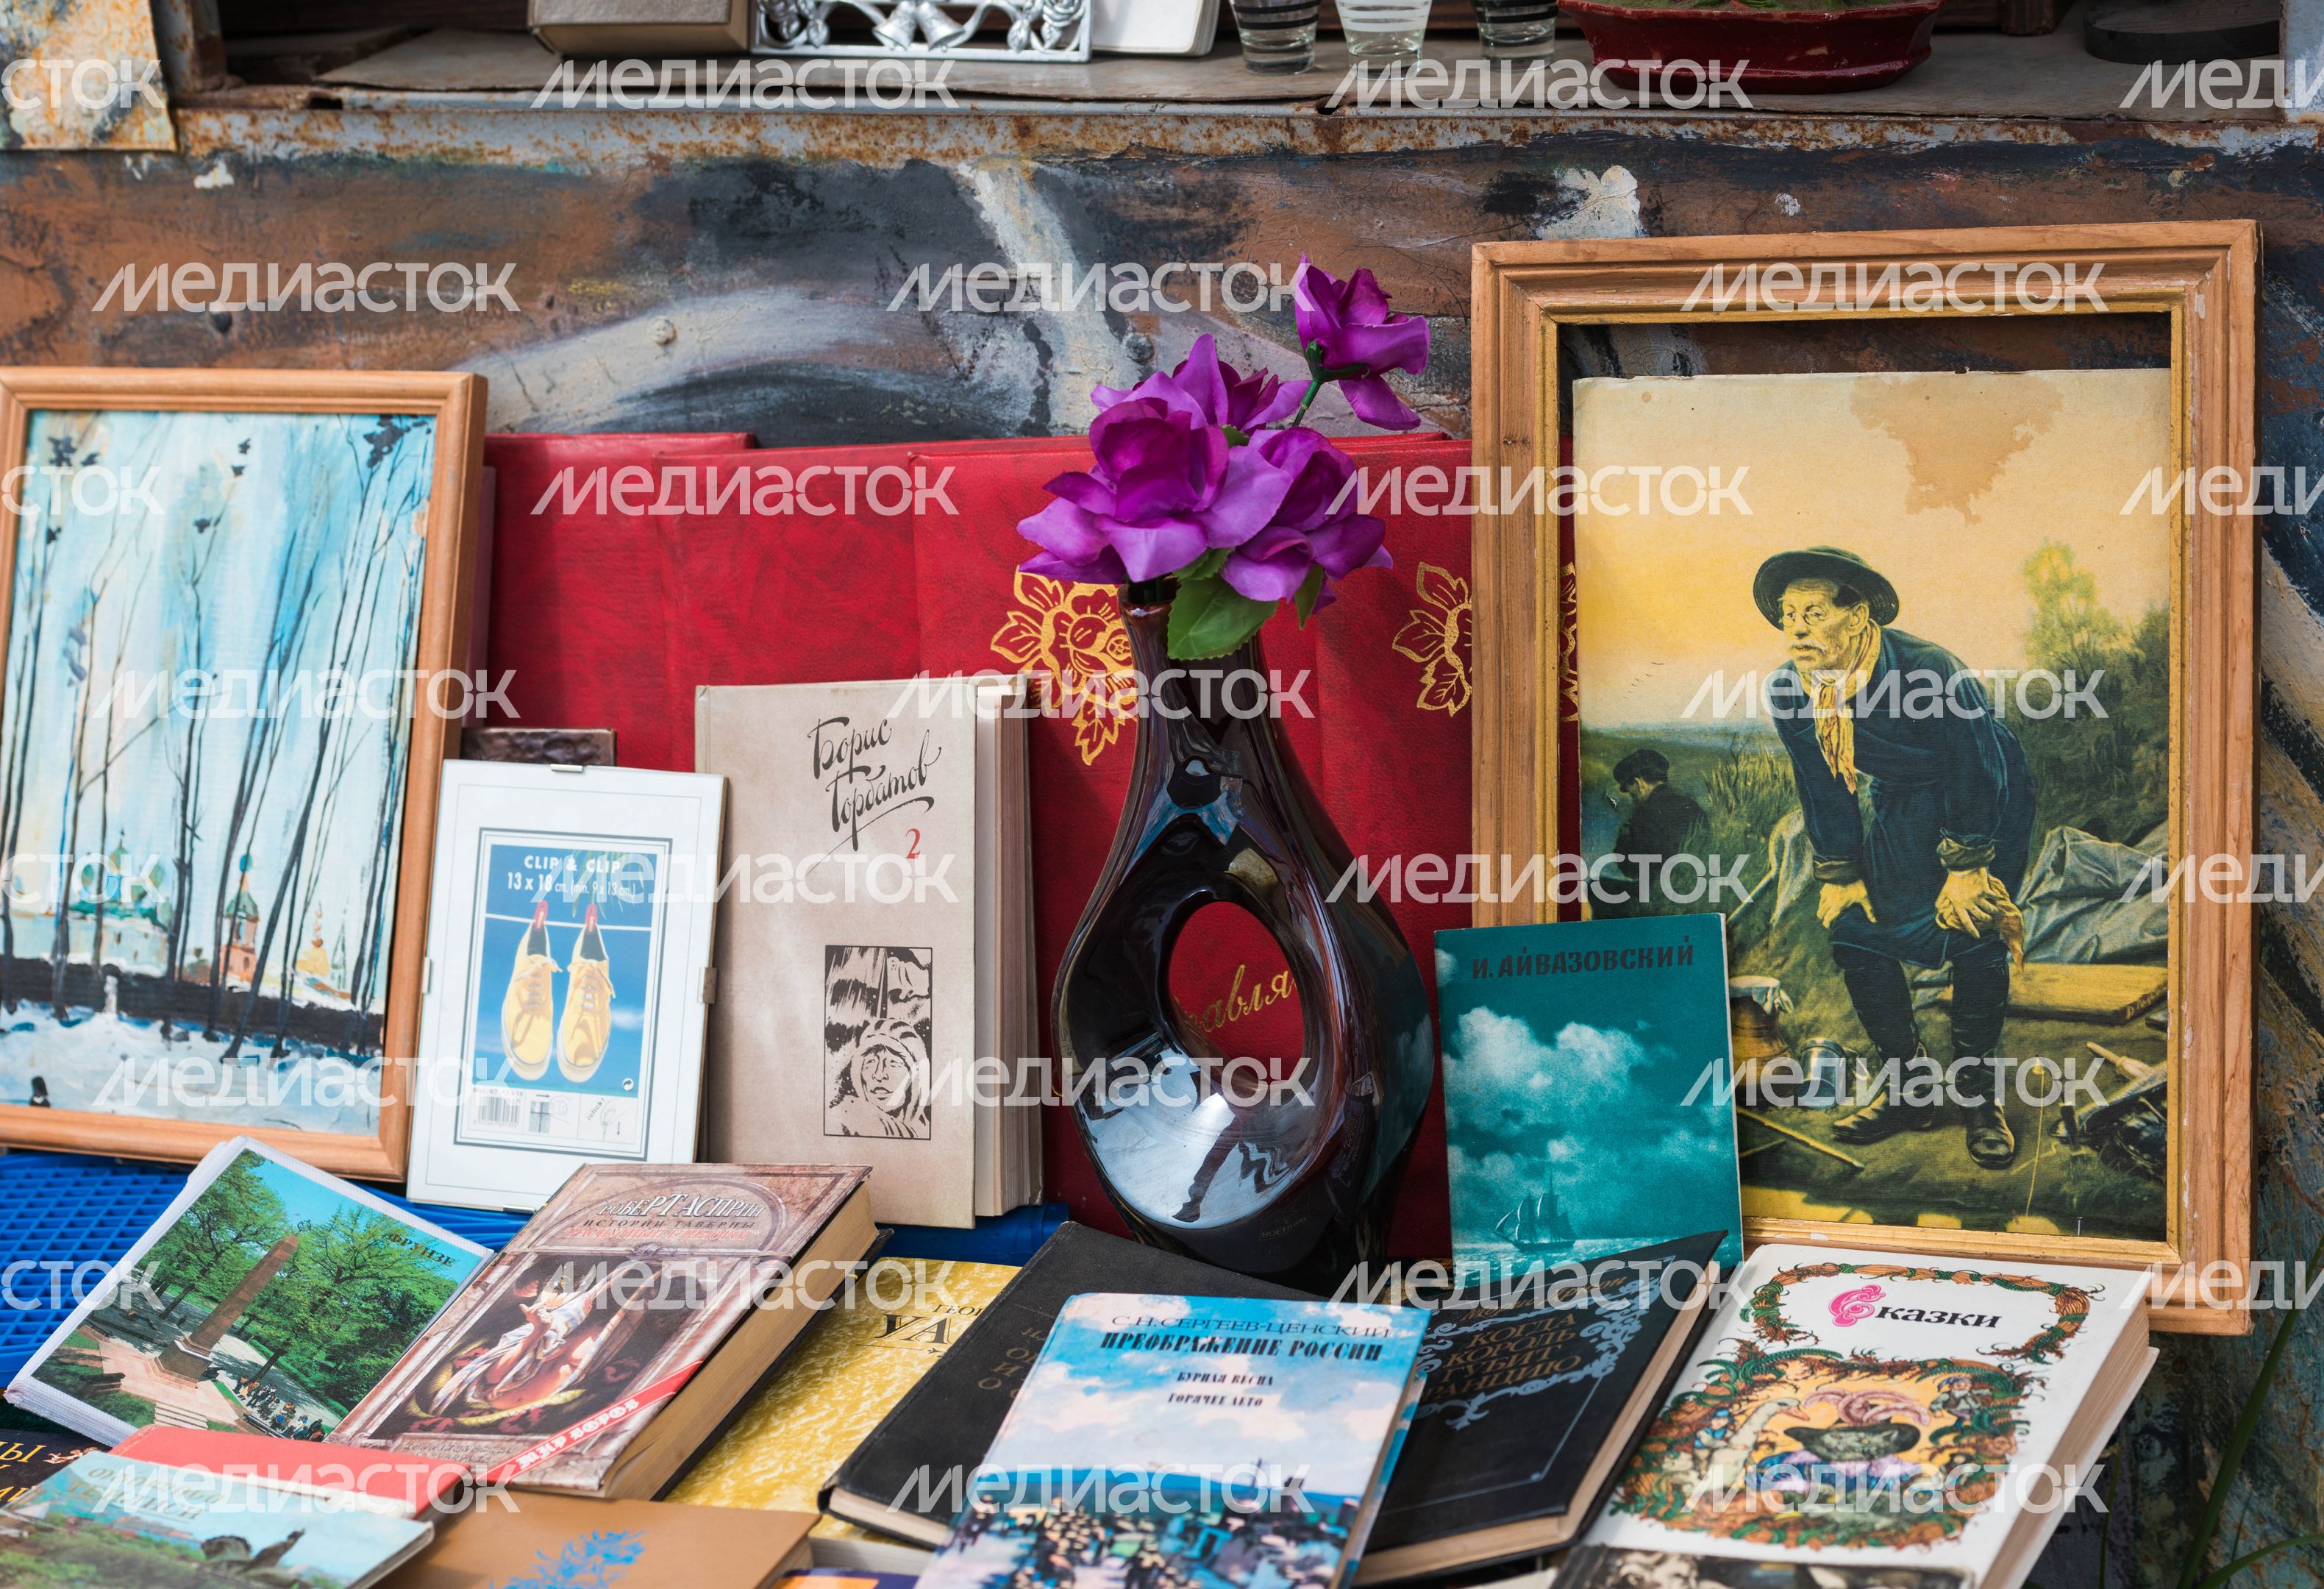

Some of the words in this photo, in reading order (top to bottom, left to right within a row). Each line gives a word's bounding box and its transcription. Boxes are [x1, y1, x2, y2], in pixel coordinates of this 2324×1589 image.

[807, 717, 892, 784] Борис
[824, 729, 942, 852] Горбатов
[905, 828, 921, 859] 2
[507, 872, 522, 891] 13
[538, 874, 553, 892] 18
[524, 855, 560, 870] CLIP
[566, 857, 577, 872] &
[585, 859, 621, 874] CLIP
[1472, 958, 1494, 980] И.
[1497, 935, 1694, 979] АЙВАЗОВСКИЙ
[597, 1193, 690, 1217] РОБЕРТ
[674, 1194, 766, 1219] АСПРИН
[582, 1219, 666, 1228] ИСТОРИИ
[674, 1220, 758, 1229] ТАВЕРНЫ
[388, 1233, 455, 1268] ФРУНЗЕ
[1828, 1284, 2003, 1329] Сказки
[1100, 1332, 1283, 1357] ПРЕОБРАЖЕНИЕ
[1288, 1340, 1383, 1362] РОССИИ
[1442, 1328, 1576, 1368] КОРОЛЬ
[1466, 1313, 1577, 1348] КОГДА
[1177, 1371, 1227, 1384] БУРНАЯ
[1231, 1374, 1274, 1386] ВЕСНА
[1421, 1354, 1582, 1400] РАНЦИЮ
[1441, 1343, 1563, 1384] ГУБИТ
[1168, 1393, 1227, 1406] ГОРЯЧЕЕ
[1232, 1396, 1263, 1407] ЛЕТО
